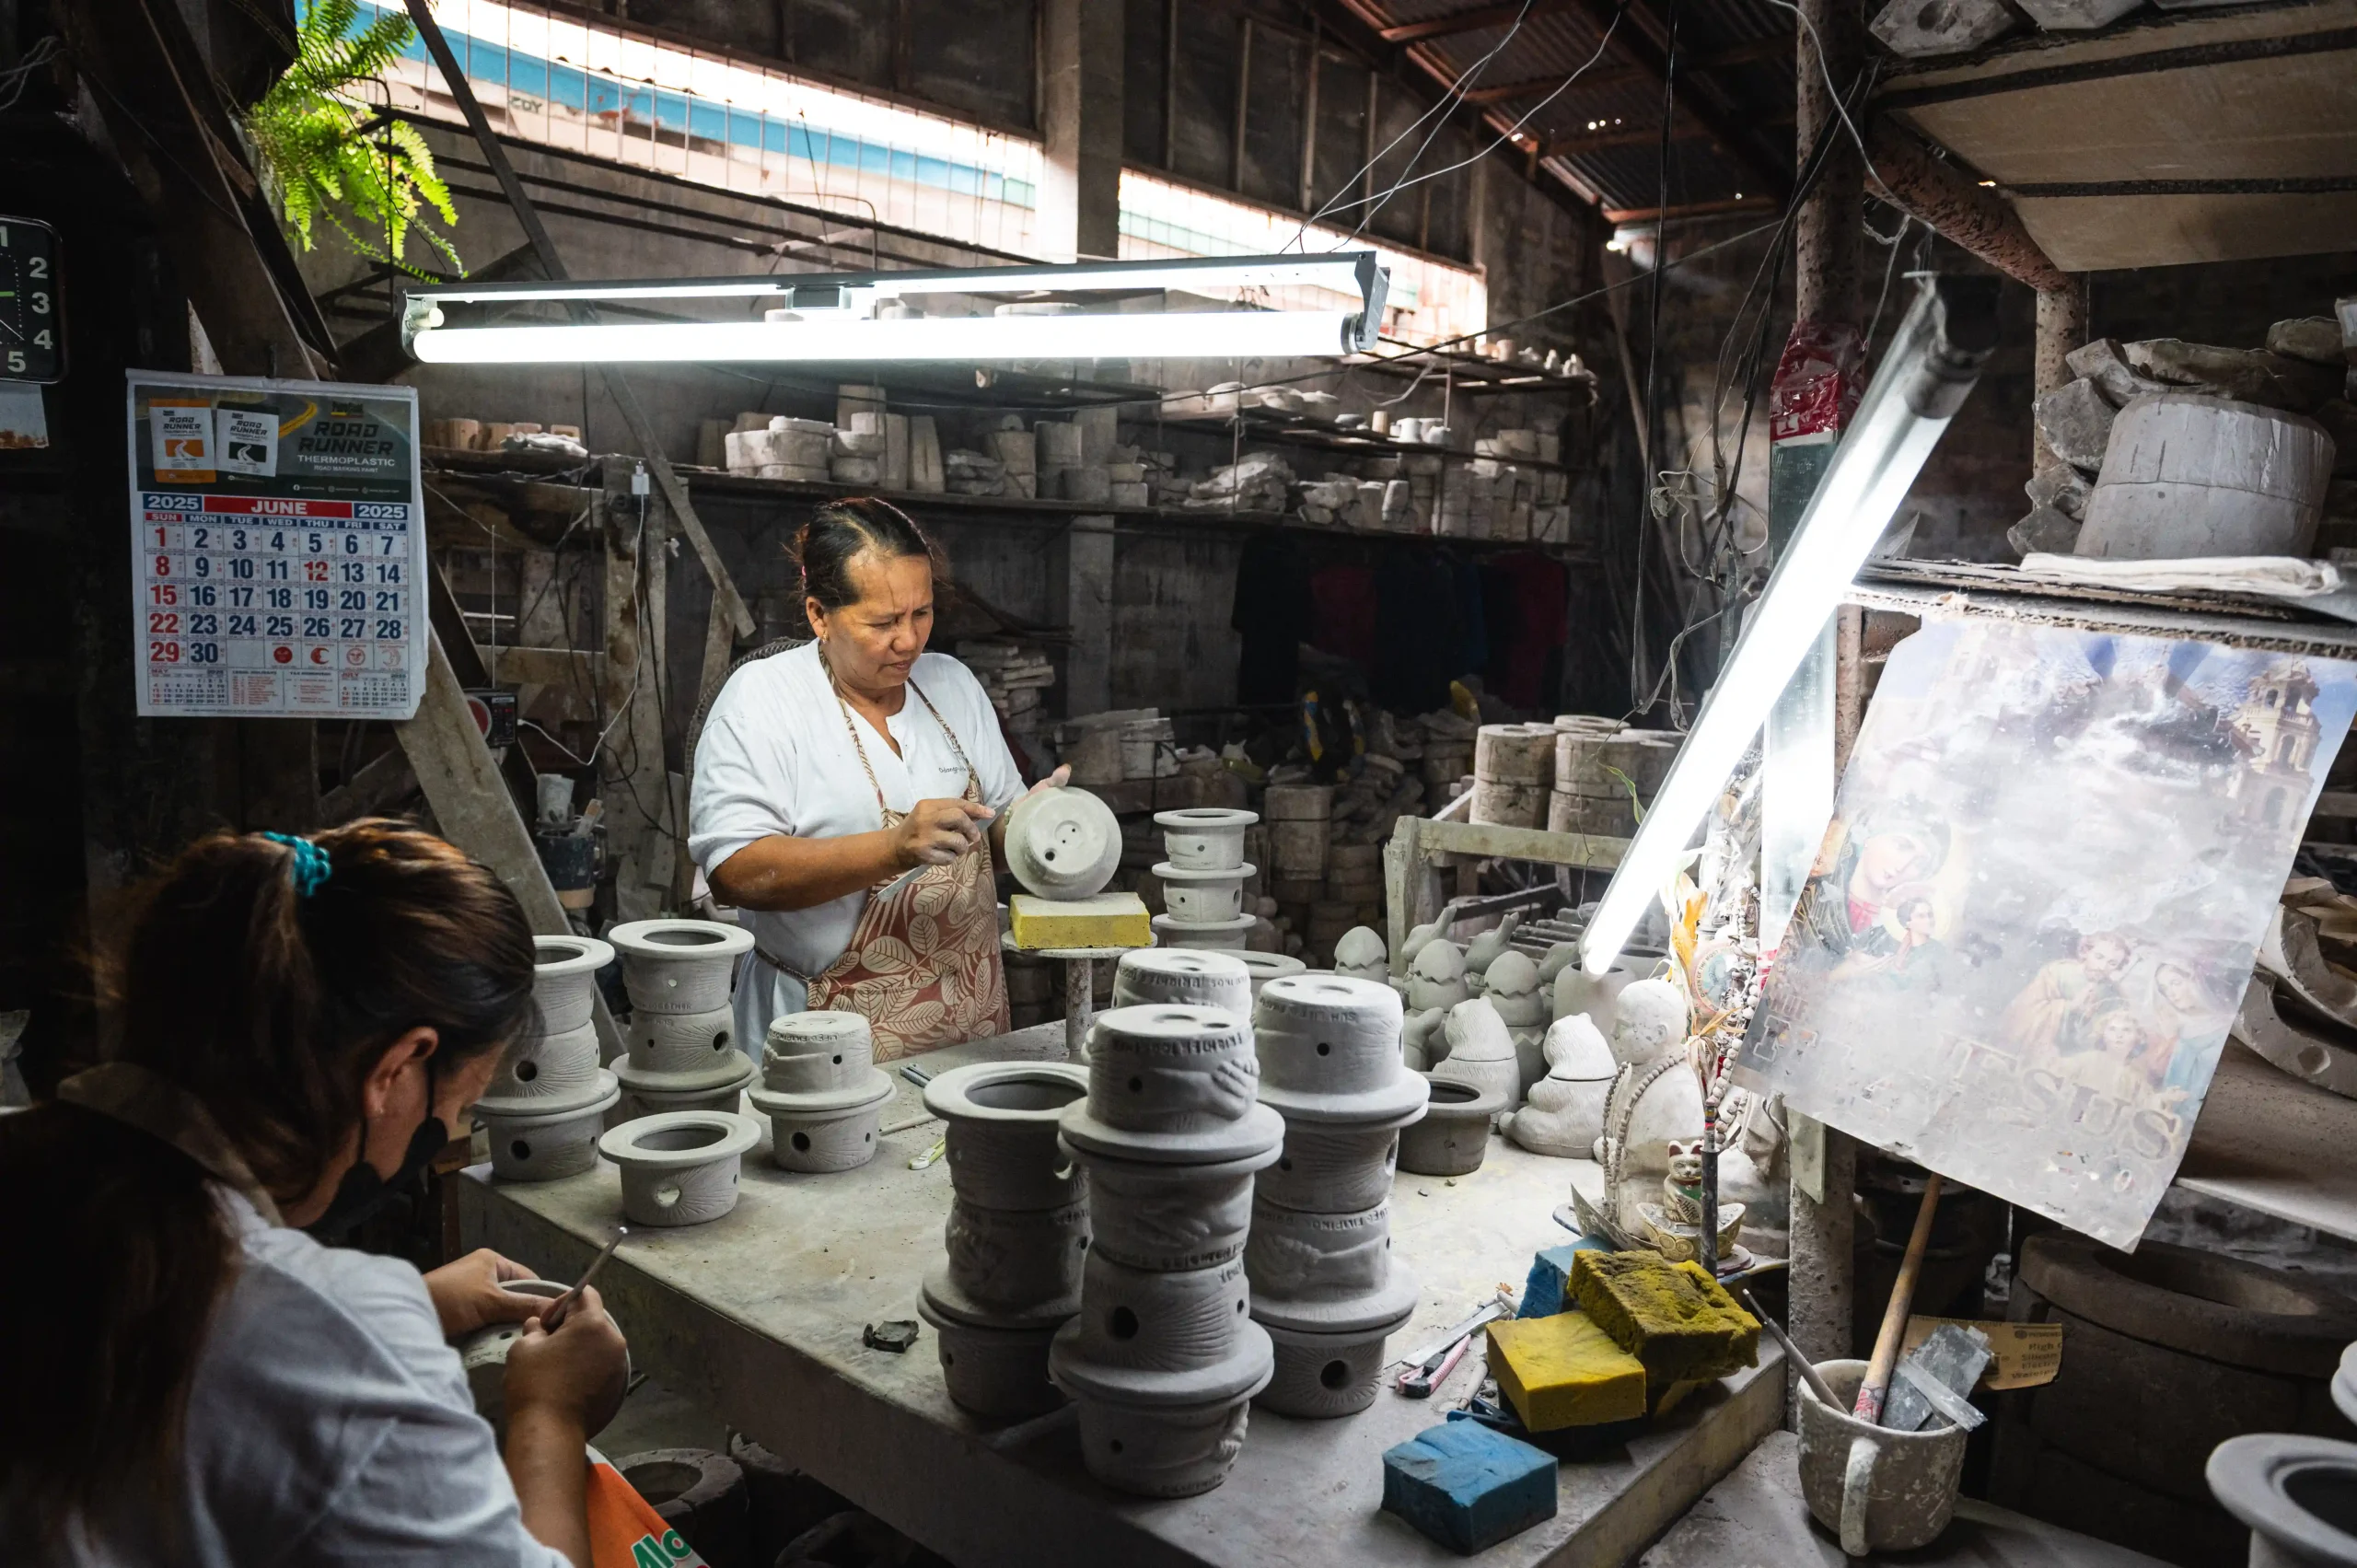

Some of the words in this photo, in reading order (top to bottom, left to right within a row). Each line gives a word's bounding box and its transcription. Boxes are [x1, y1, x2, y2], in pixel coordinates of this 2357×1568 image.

[29, 257, 48, 279] 2
[31, 292, 51, 314] 3
[33, 330, 52, 349] 4
[7, 351, 26, 373] 5
[230, 426, 267, 436] RUNNER
[314, 421, 378, 437] ROAD
[298, 437, 394, 455] RUNNER
[297, 454, 395, 467] THERMOPLASTIC
[148, 495, 199, 510] 2025
[250, 500, 308, 515] JUNE
[358, 505, 405, 518] 2025
[190, 515, 217, 523] MON
[306, 519, 329, 528] THU
[155, 527, 165, 547] 1
[194, 528, 209, 549] 2
[233, 529, 247, 550] 3
[271, 532, 284, 552] 4
[308, 533, 322, 553] 5
[345, 534, 358, 554] 6
[380, 536, 393, 555] 7
[156, 555, 169, 575] 8
[195, 557, 209, 577] 9
[228, 559, 253, 578] 10
[266, 560, 287, 580] 11
[304, 561, 328, 581] 12
[341, 563, 364, 583] 13
[377, 564, 401, 584] 14
[150, 584, 177, 605] 15
[190, 586, 215, 606] 16
[229, 587, 253, 607] 17
[266, 588, 292, 608] 18
[305, 589, 329, 610] 19
[340, 590, 366, 610] 20
[376, 591, 399, 611] 21
[150, 613, 179, 633] 22
[190, 614, 217, 634] 23
[228, 615, 256, 635] 24
[266, 616, 293, 636] 25
[304, 617, 331, 637] 26
[341, 619, 366, 638] 27
[376, 620, 401, 639] 28
[150, 642, 180, 662] 29
[191, 643, 218, 663] 30
[1697, 979, 1705, 997] QUEEN
